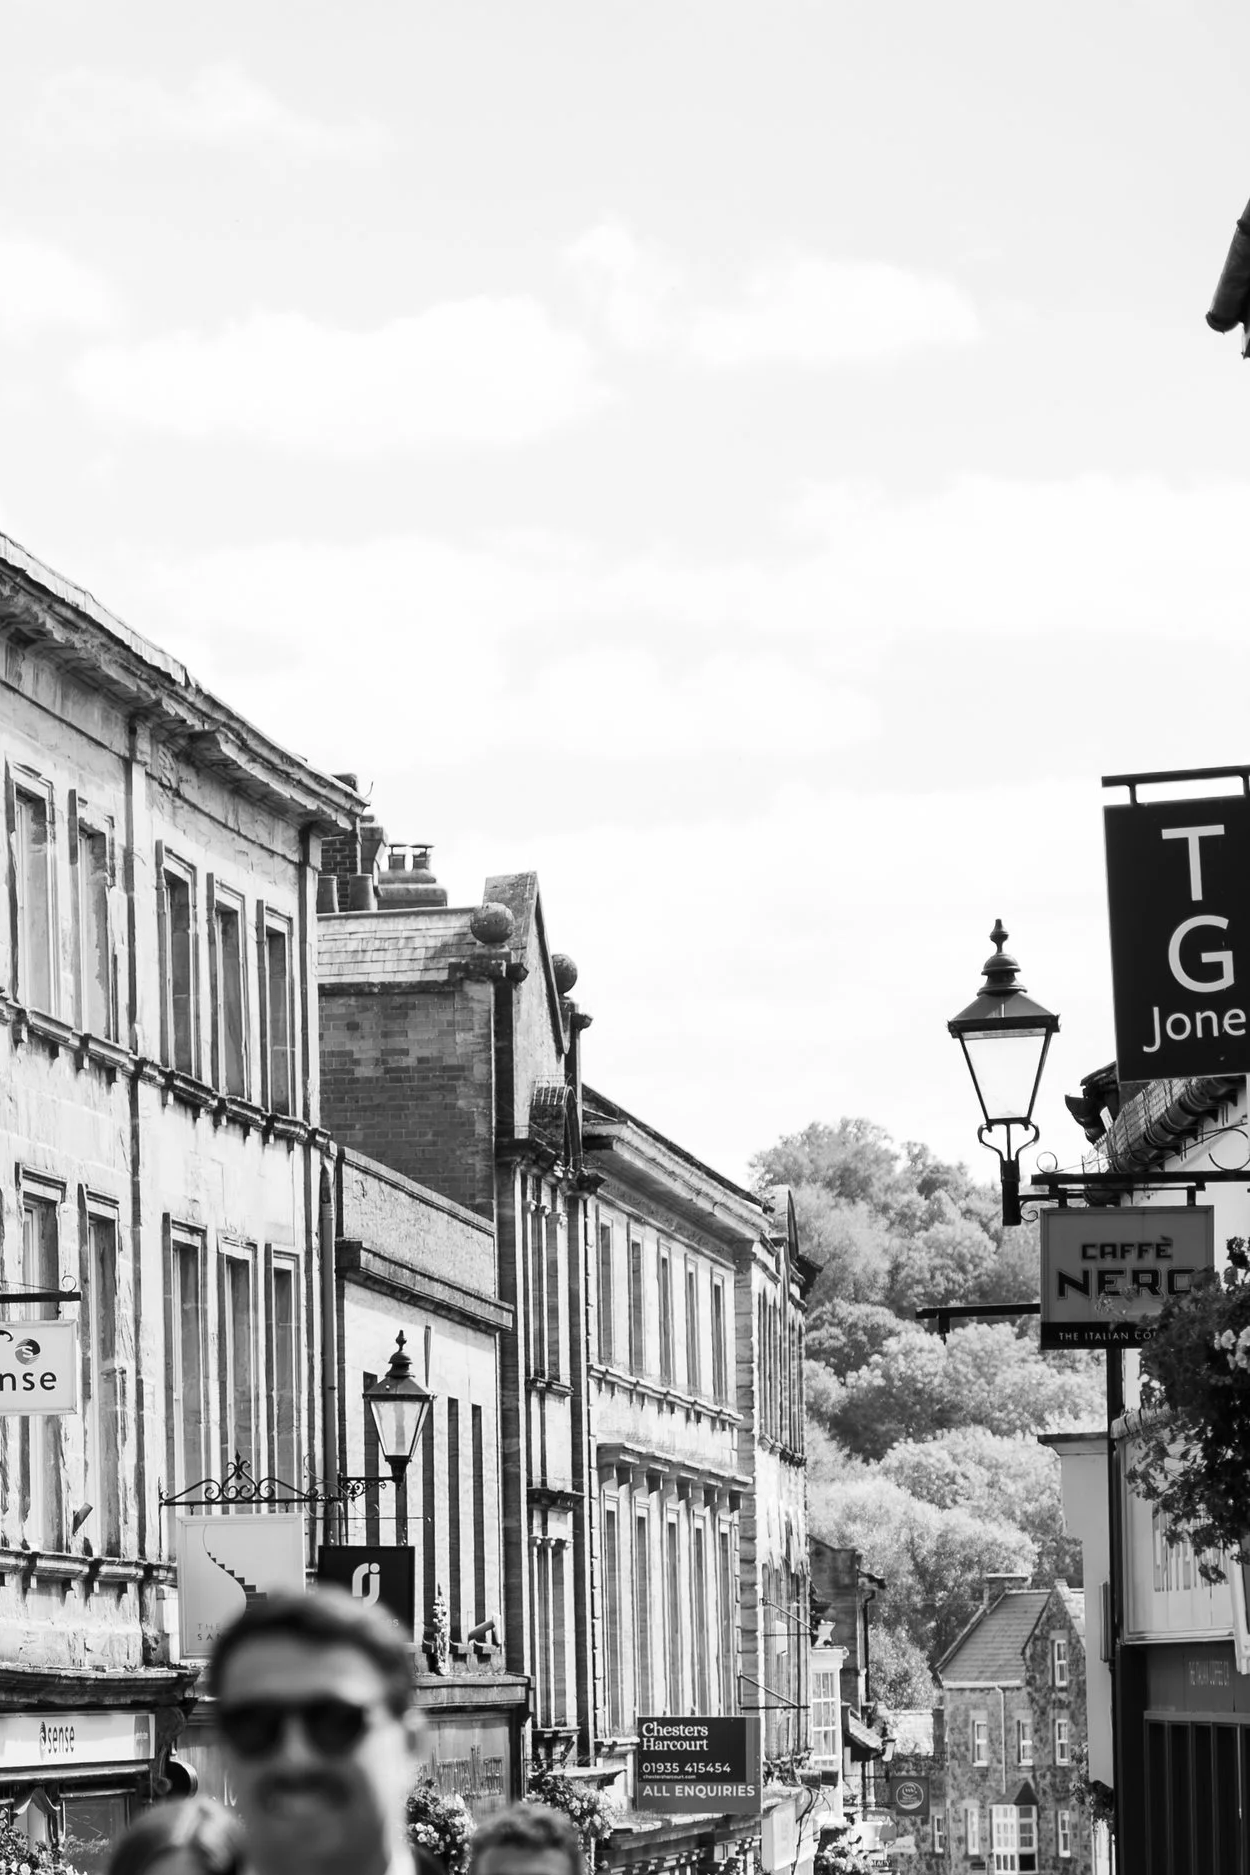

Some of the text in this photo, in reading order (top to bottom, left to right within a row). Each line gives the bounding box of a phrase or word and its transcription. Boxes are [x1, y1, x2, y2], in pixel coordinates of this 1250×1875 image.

[1161, 824, 1225, 901] T
[1168, 914, 1235, 993] G
[1143, 1006, 1247, 1053] Jone
[1059, 1331, 1079, 1341] THE
[1085, 1330, 1129, 1341] ITALIAN
[197, 1622, 221, 1631] THE
[197, 1633, 223, 1641] SAN
[642, 1721, 708, 1737] Chesters
[47, 1725, 75, 1754] sense
[642, 1737, 709, 1751] Harcourt
[642, 1762, 731, 1773] 01935 415454
[642, 1785, 756, 1799] ALL ENQUIRIES
